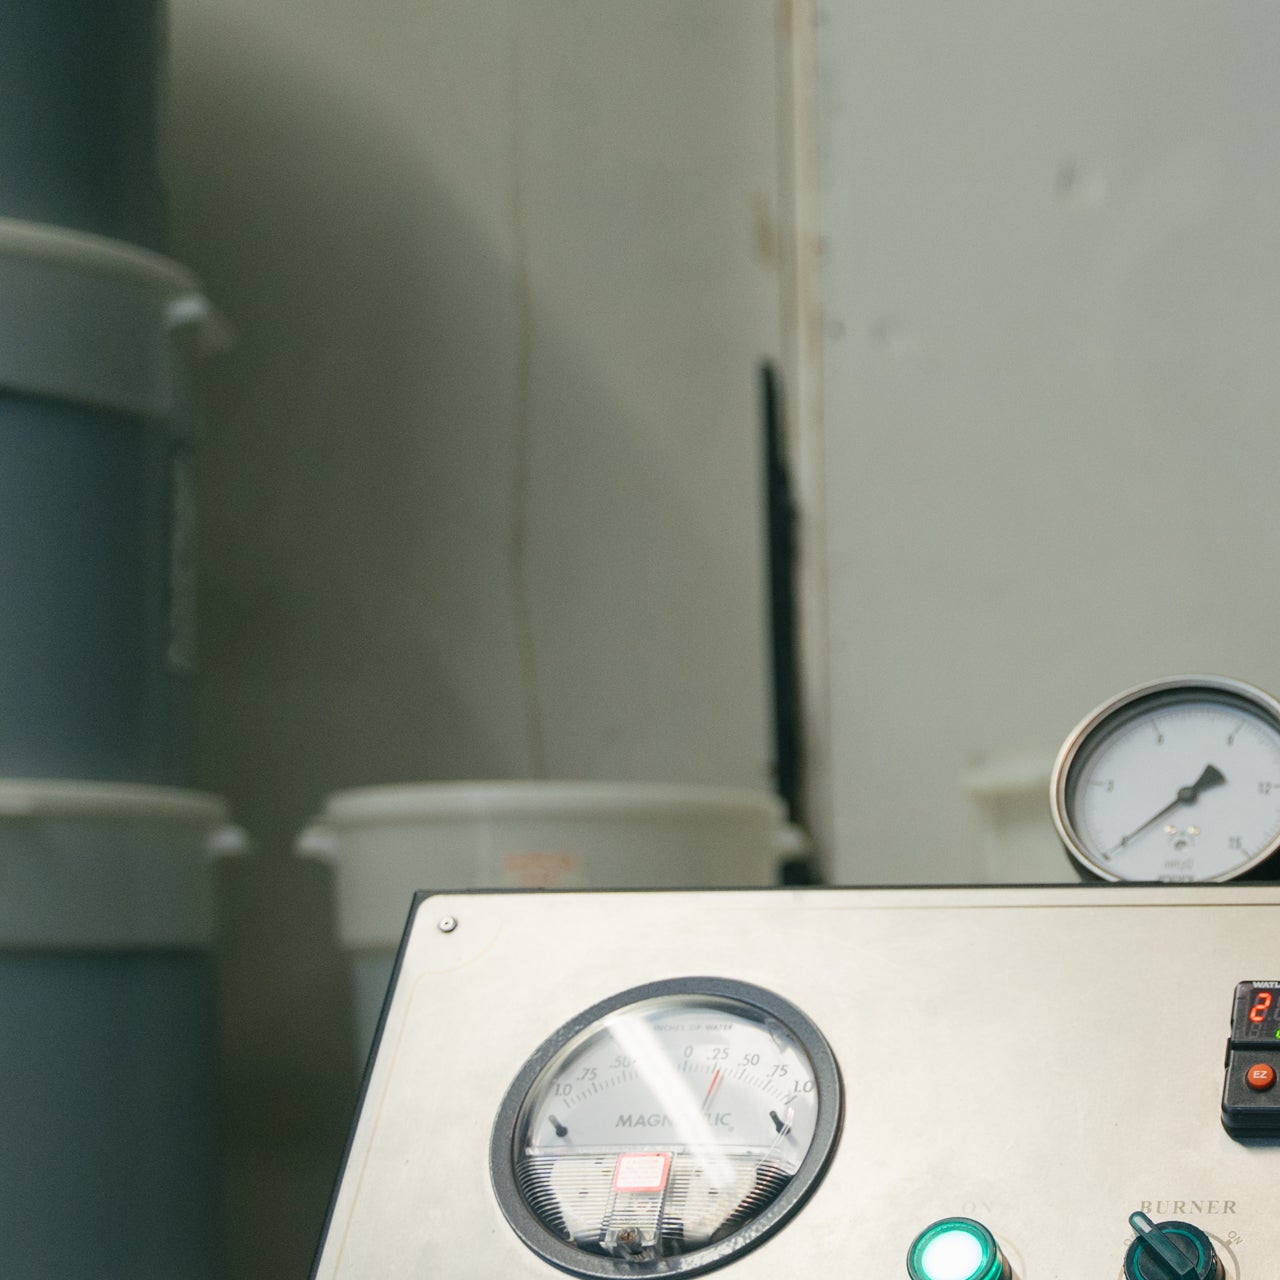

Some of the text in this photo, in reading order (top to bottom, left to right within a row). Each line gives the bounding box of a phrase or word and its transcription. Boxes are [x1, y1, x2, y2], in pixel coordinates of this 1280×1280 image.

[1253, 1070, 1267, 1079] EZ
[1140, 1200, 1237, 1214] BURNER
[1227, 1229, 1243, 1245] ON
